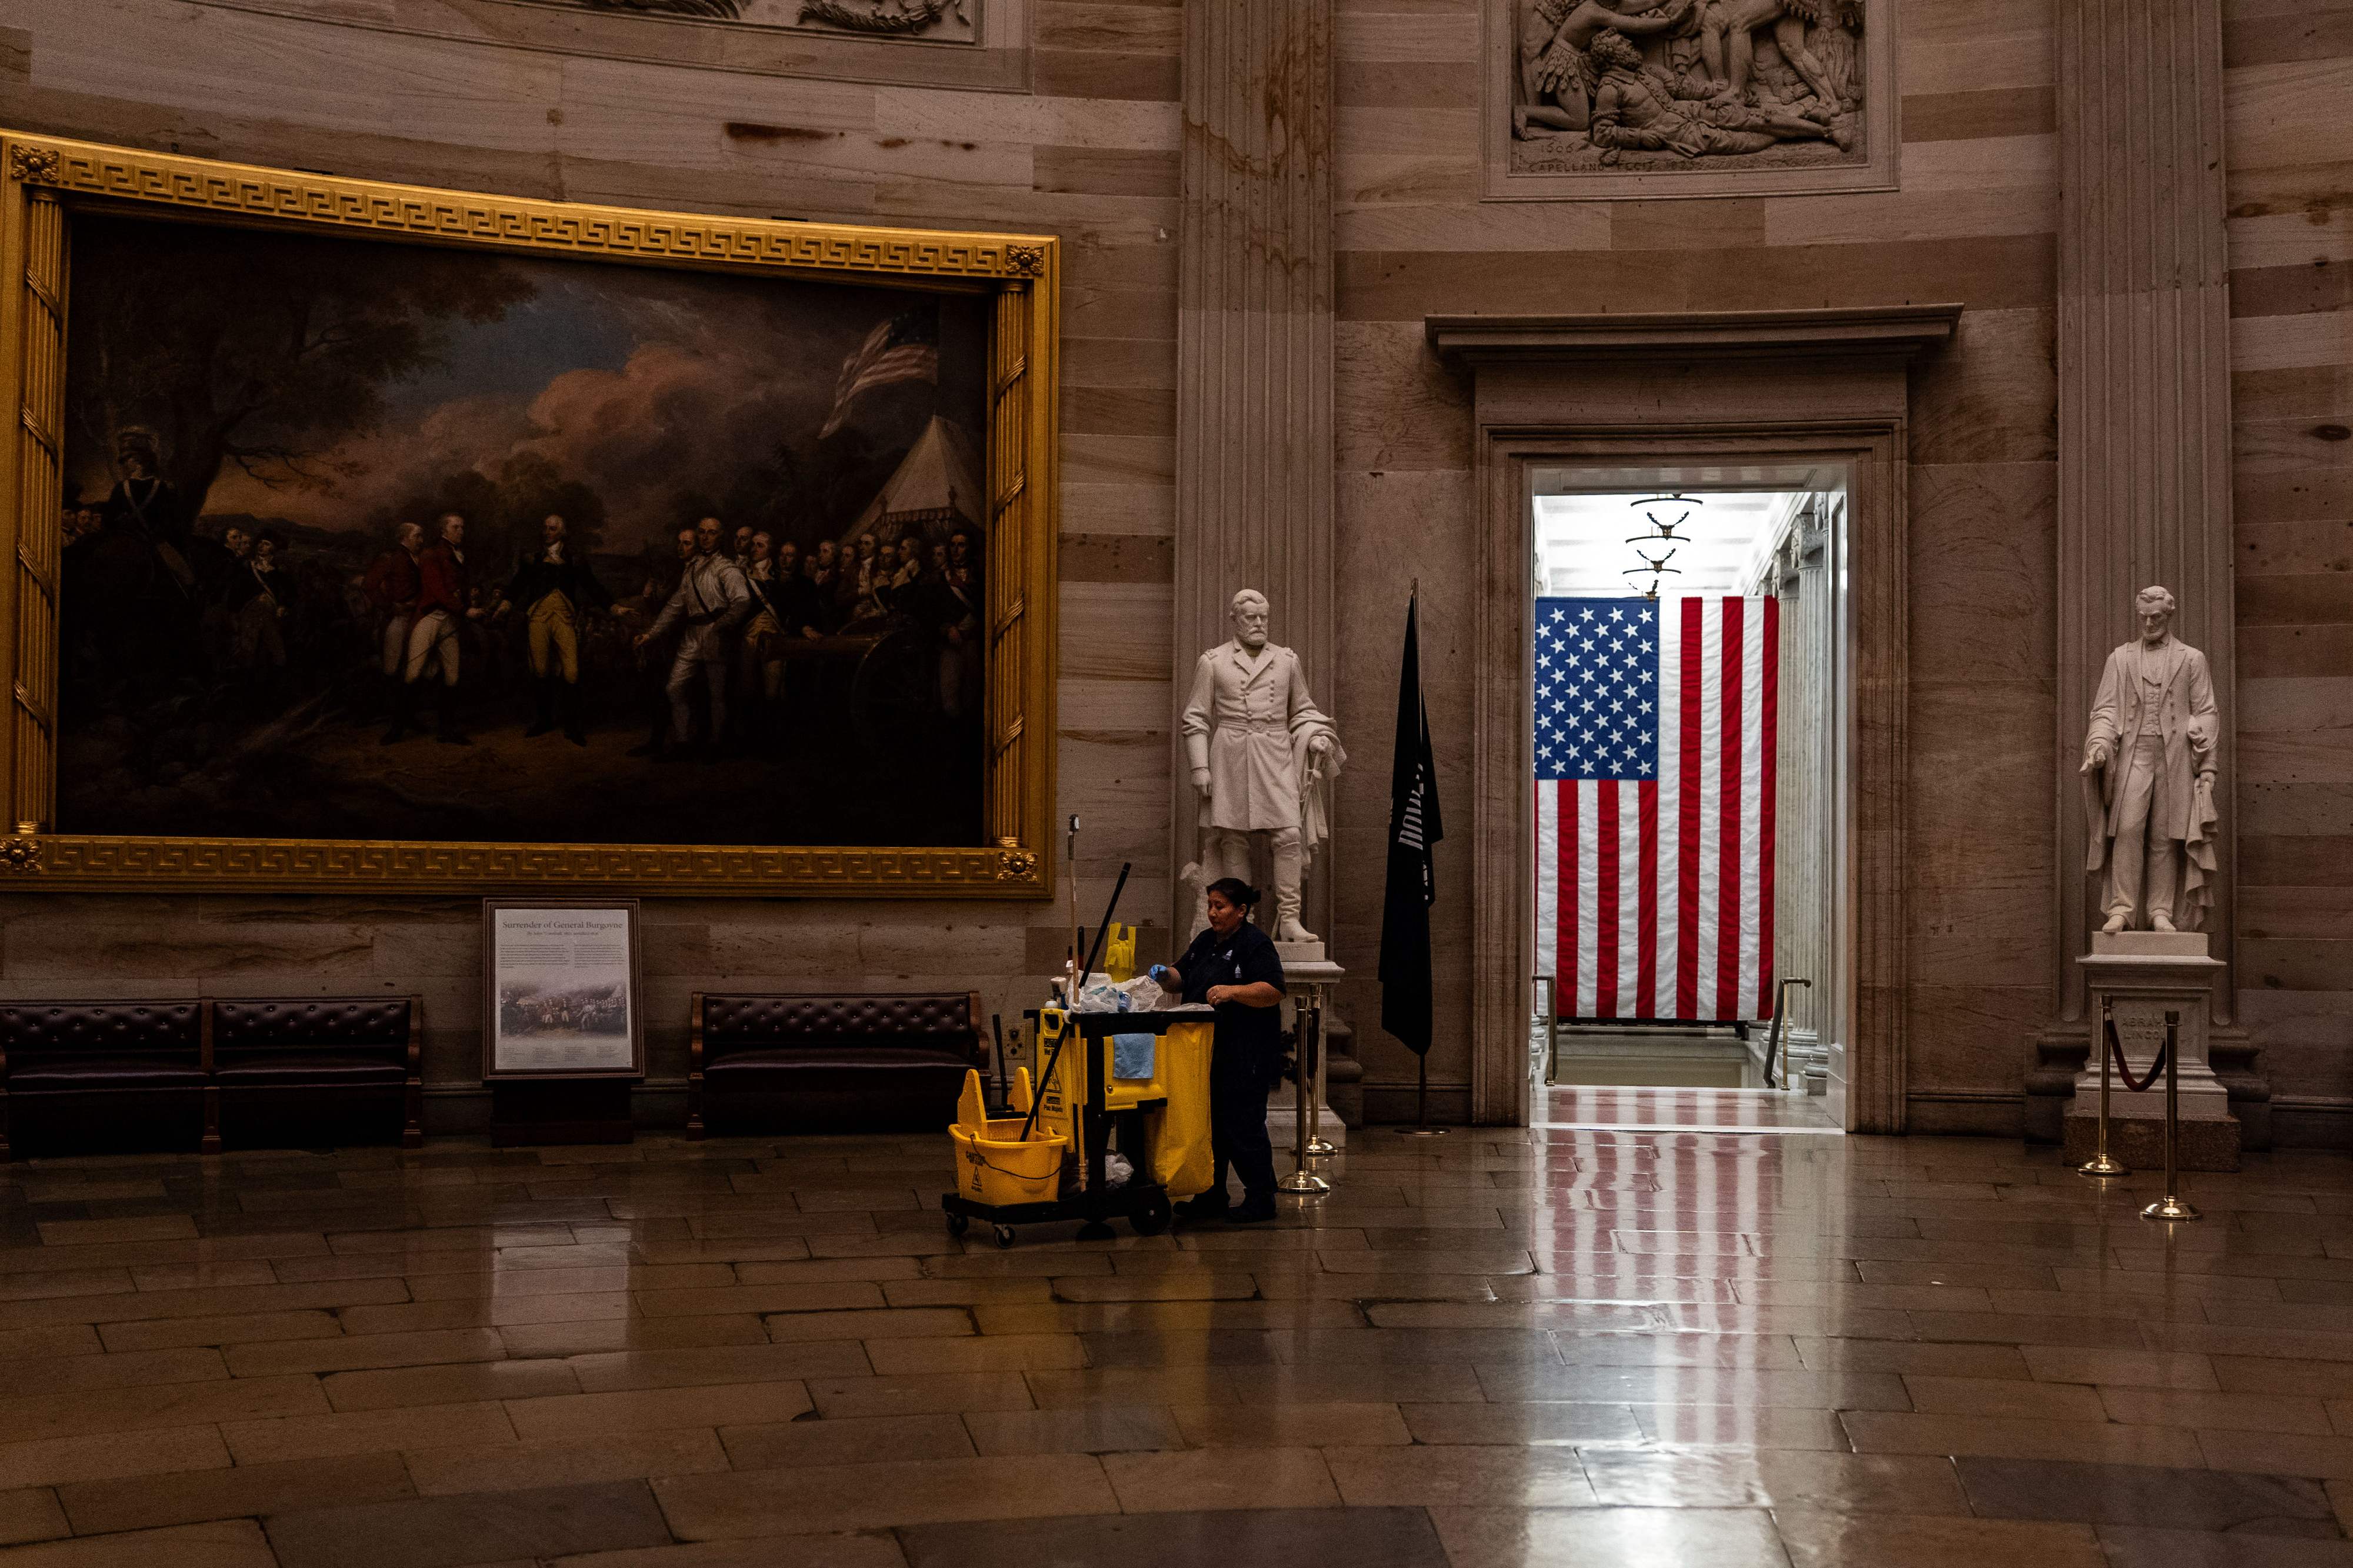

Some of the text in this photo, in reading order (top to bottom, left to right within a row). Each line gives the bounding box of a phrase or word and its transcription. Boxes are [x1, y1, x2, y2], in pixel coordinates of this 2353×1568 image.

[1541, 142, 1574, 154] 1606
[1529, 164, 1605, 172] CAPELLANO
[503, 920, 542, 929] Surrender
[544, 920, 553, 929] of
